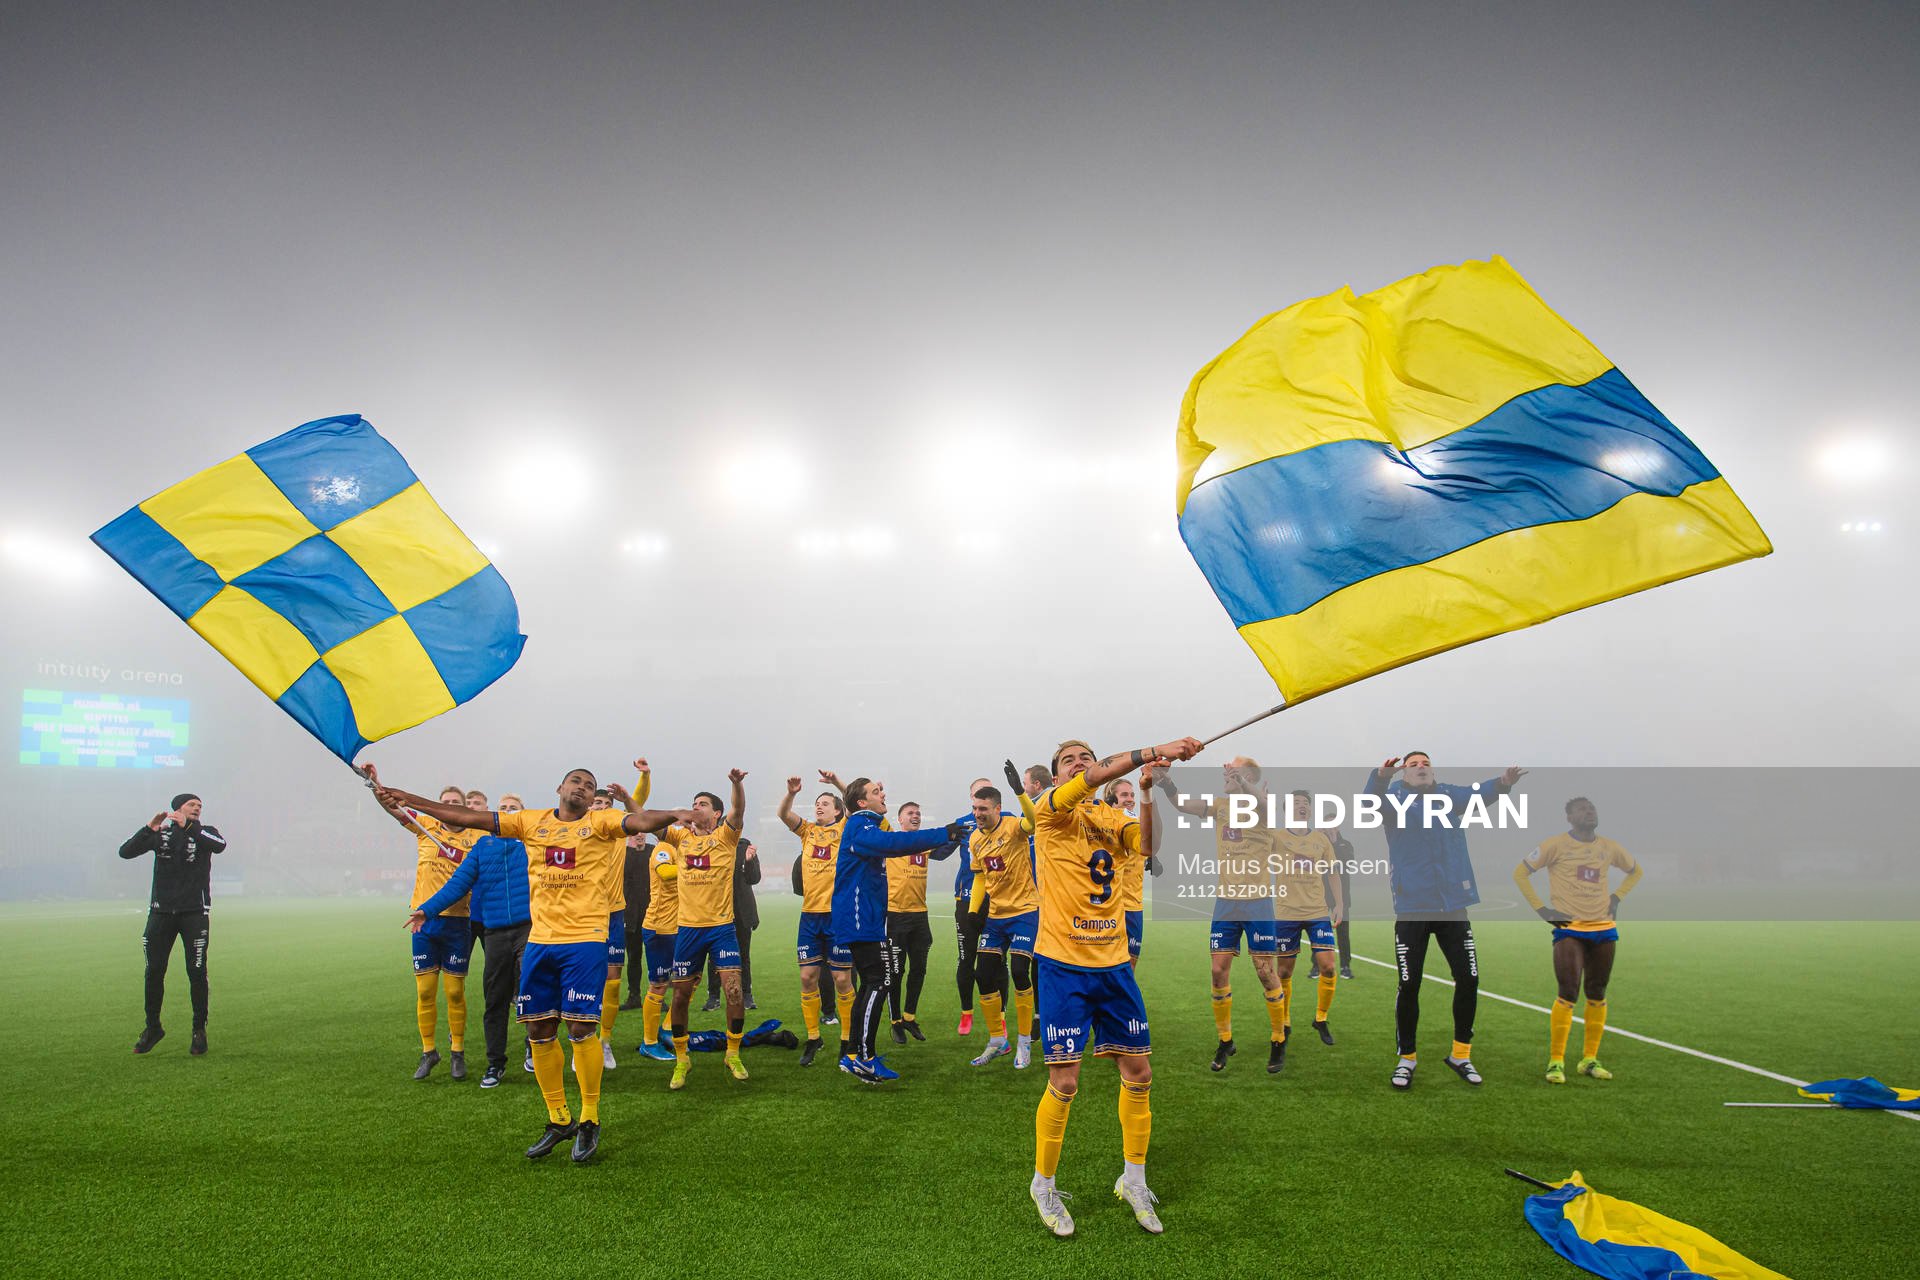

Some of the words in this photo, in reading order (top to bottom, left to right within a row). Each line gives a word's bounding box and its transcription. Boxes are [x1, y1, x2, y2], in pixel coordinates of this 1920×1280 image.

[121, 668, 183, 685] arena
[554, 851, 566, 864] U
[694, 858, 702, 867] U
[915, 855, 922, 864] U
[990, 859, 998, 869] U
[1087, 849, 1115, 904] 9
[1073, 915, 1117, 931] Campos
[1211, 940, 1219, 949] 16
[1281, 943, 1286, 951] 8
[799, 951, 807, 959] 18
[1398, 955, 1409, 981] NYMO
[1468, 951, 1478, 976] NYMO
[678, 968, 688, 976] 19
[1058, 1027, 1081, 1036] NYMO
[1066, 1038, 1075, 1053] 9
